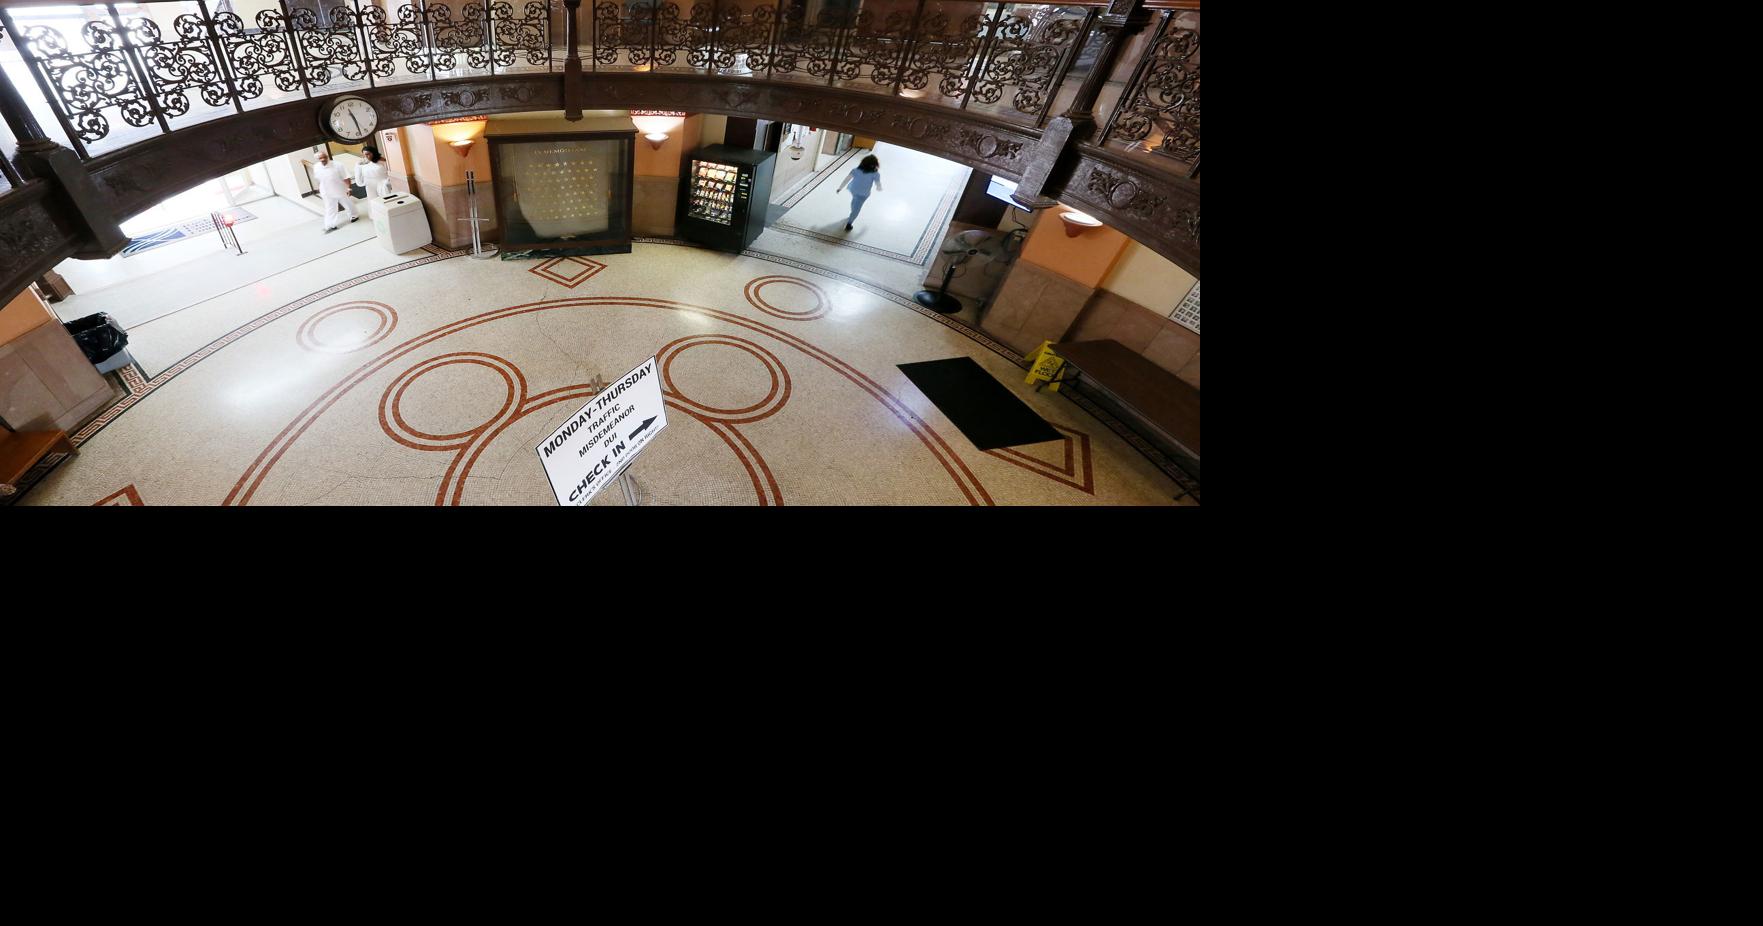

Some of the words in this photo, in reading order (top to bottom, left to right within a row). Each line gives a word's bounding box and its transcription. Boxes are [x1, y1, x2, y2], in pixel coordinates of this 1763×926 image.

[543, 363, 652, 457] MONDAY-THURSDAY
[578, 404, 636, 458] MISDEMEANOR
[588, 404, 620, 434] TRAFFIC
[604, 432, 618, 448] DUI
[569, 454, 611, 502] CHECK
[612, 440, 626, 458] IN
